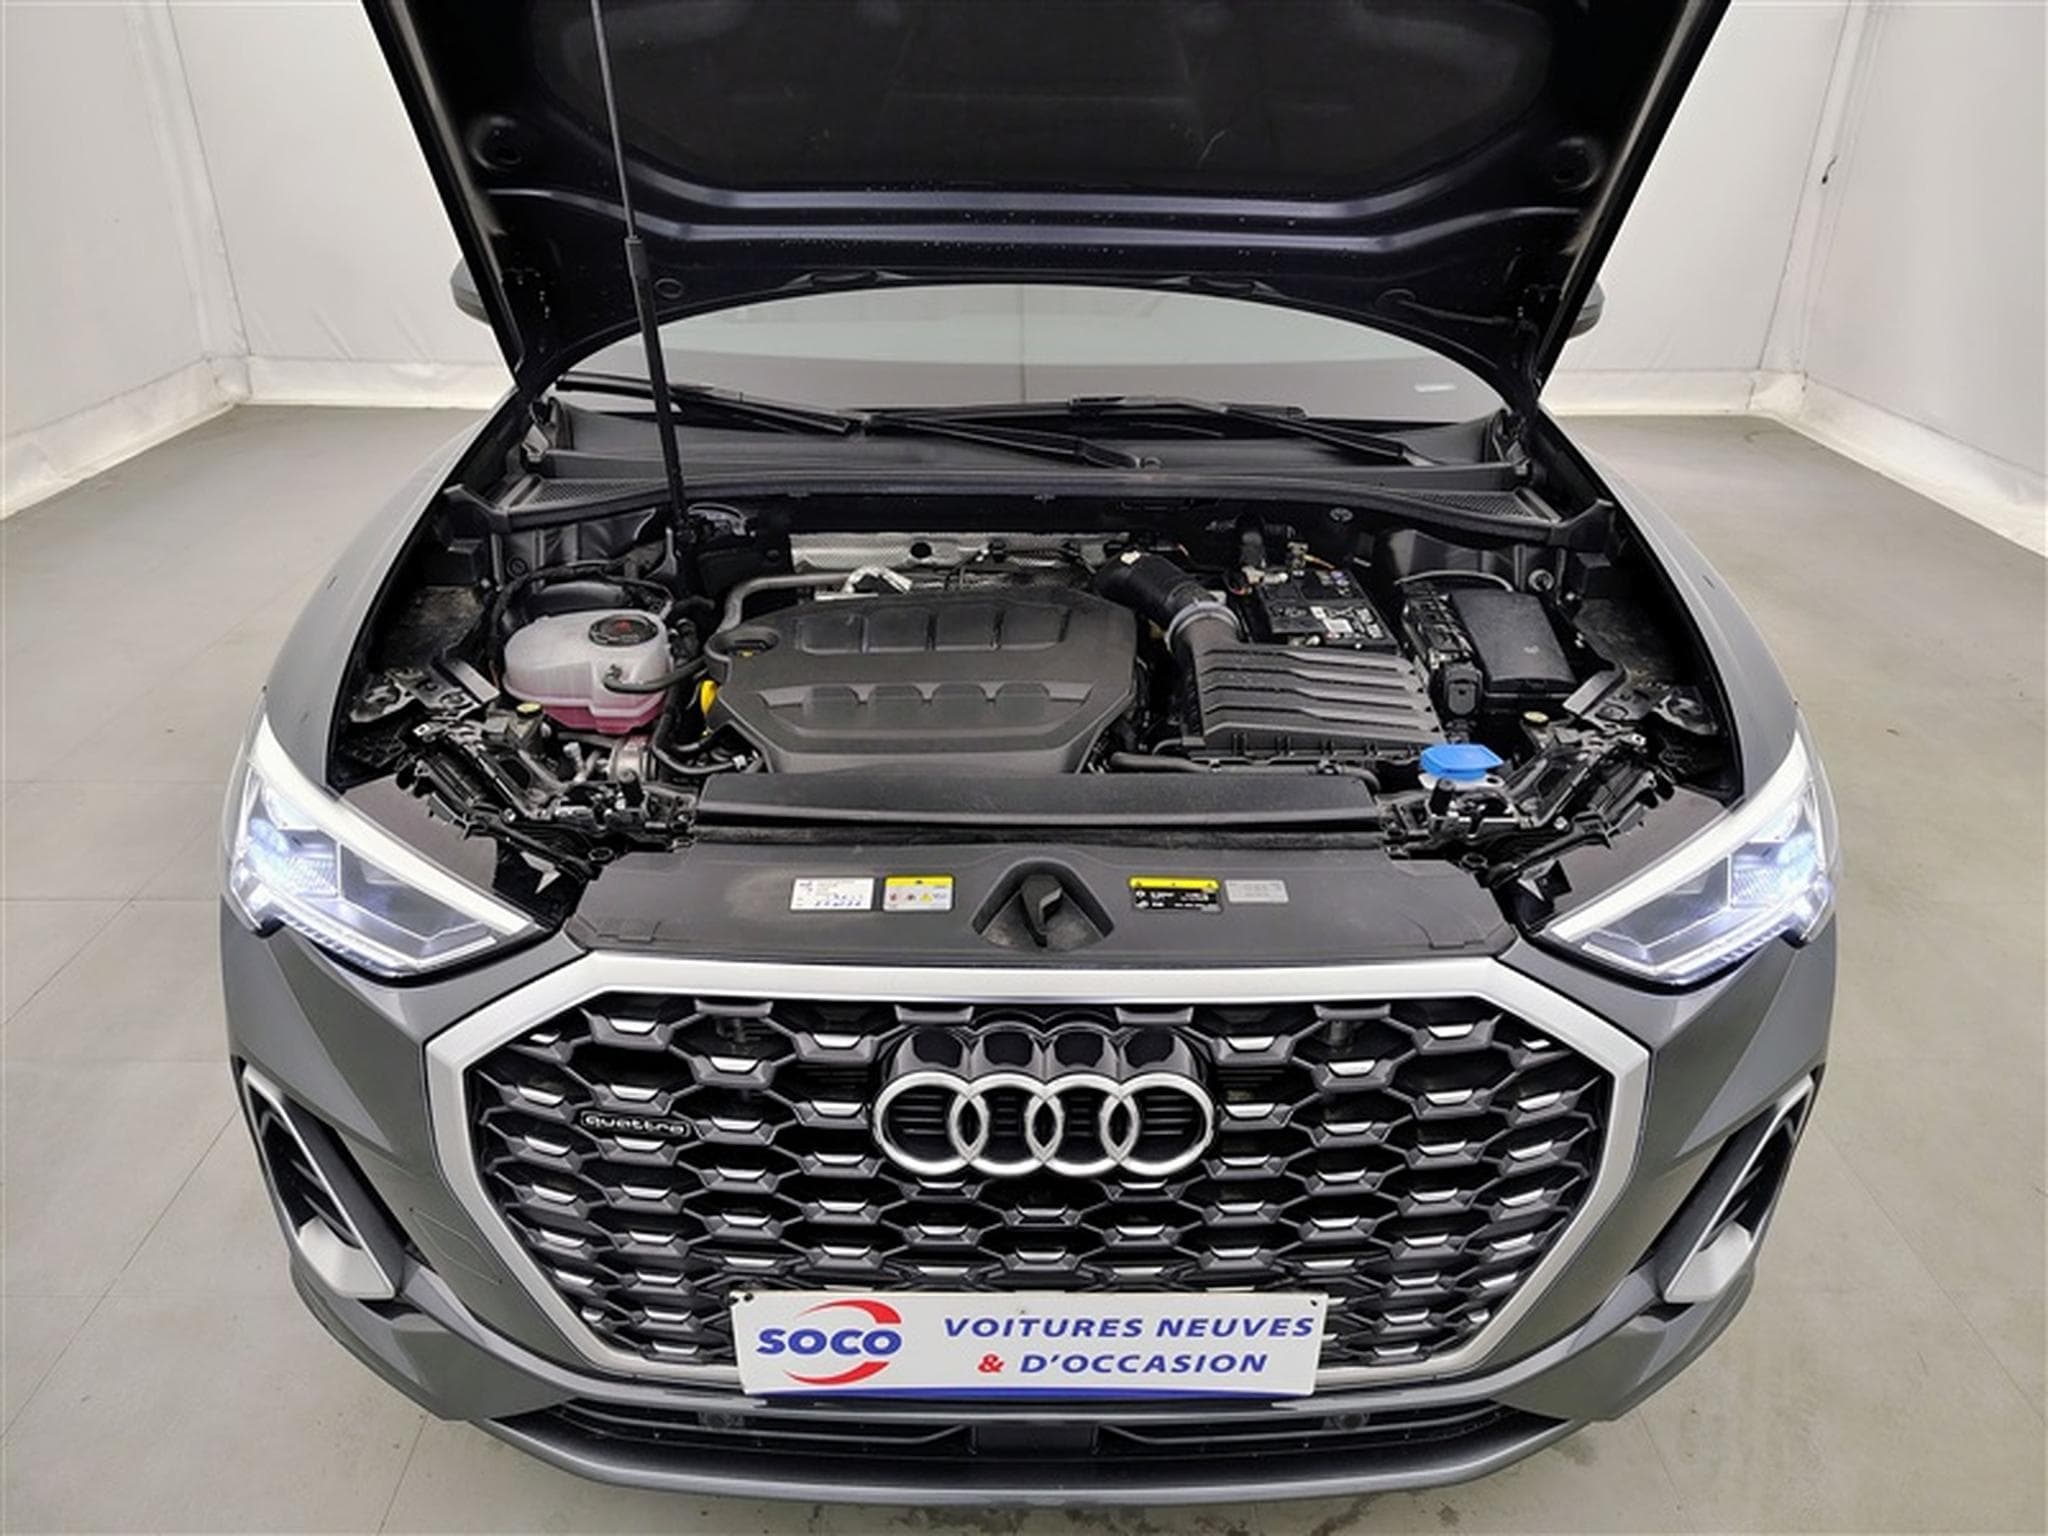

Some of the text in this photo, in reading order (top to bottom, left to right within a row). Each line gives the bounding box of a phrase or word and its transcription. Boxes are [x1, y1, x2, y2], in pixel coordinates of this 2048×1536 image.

[585, 1115, 684, 1132] quattro
[944, 1318, 1314, 1338] VOITURES NEUVES
[756, 1328, 902, 1355] SOCO
[977, 1353, 1268, 1374] & D'OCCASION
